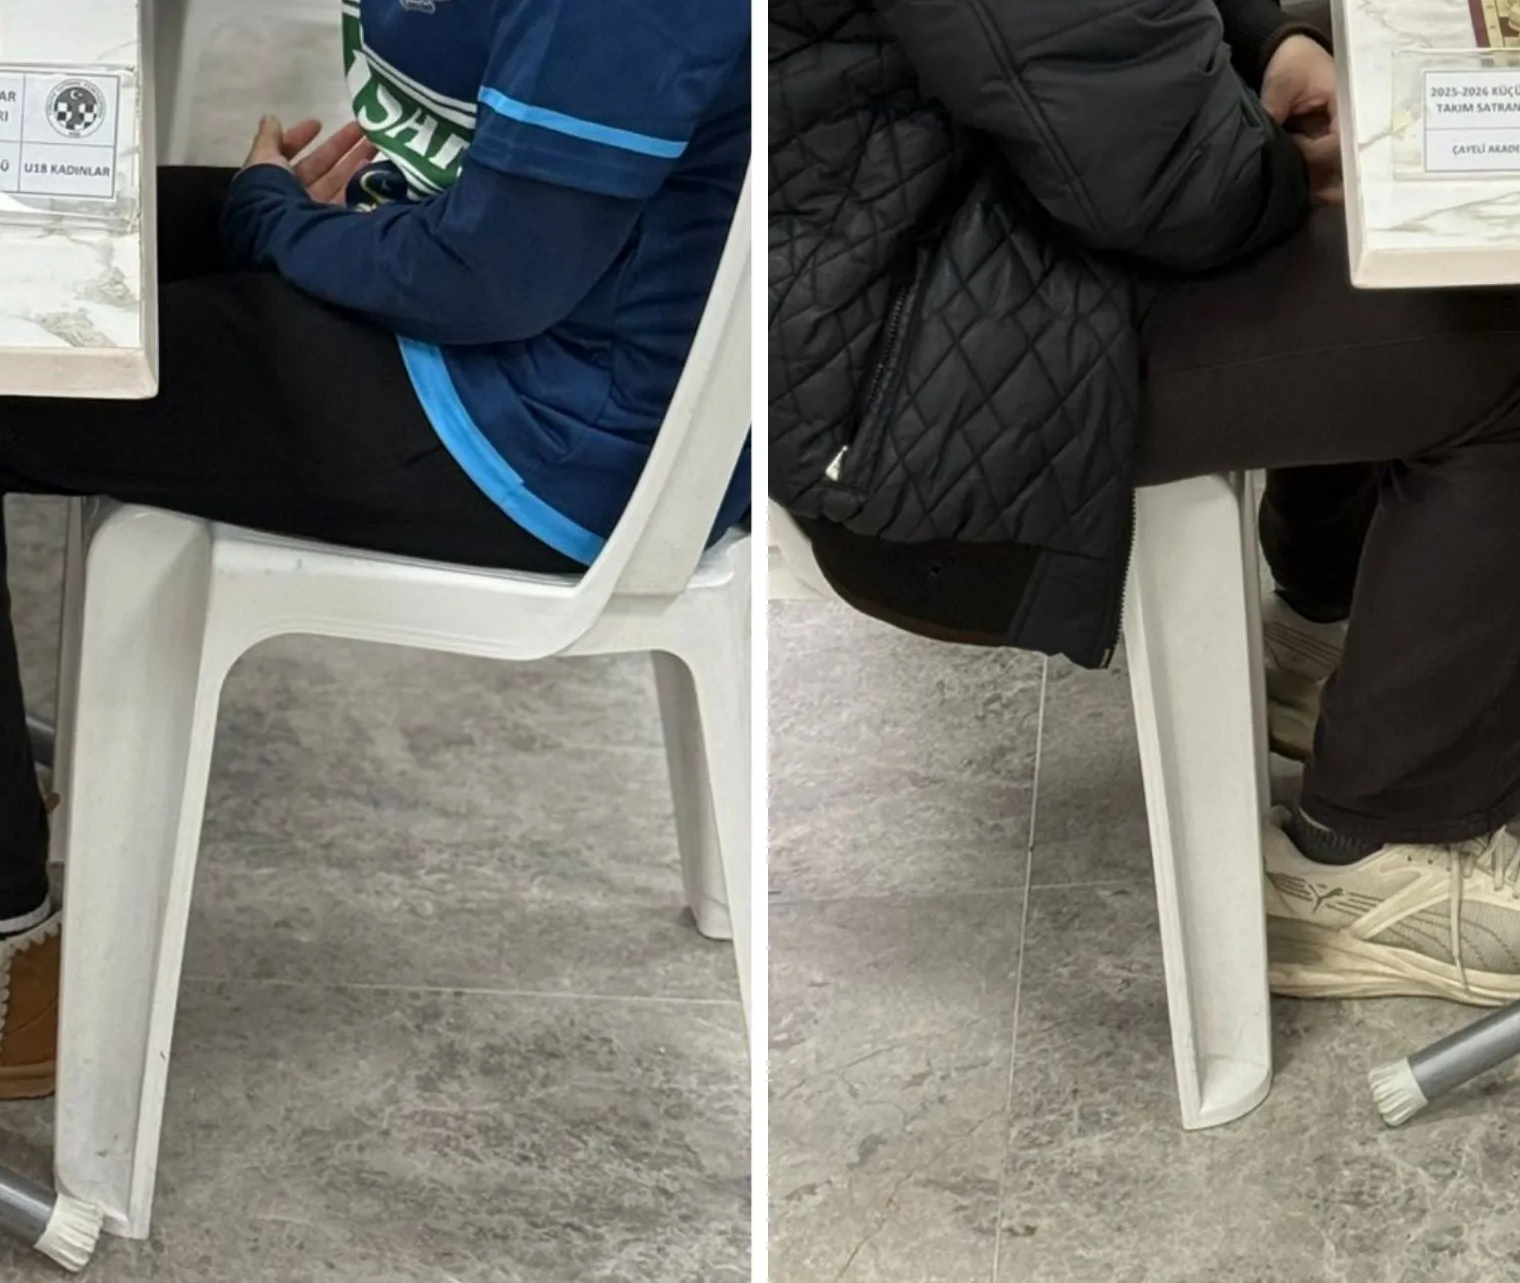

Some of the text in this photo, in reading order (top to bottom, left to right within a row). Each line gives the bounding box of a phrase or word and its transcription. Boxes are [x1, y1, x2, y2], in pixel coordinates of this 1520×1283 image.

[1431, 85, 1489, 97] 2025-2026
[1437, 102, 1474, 113] TAKIM
[24, 162, 110, 177] U18 KADINLAR
